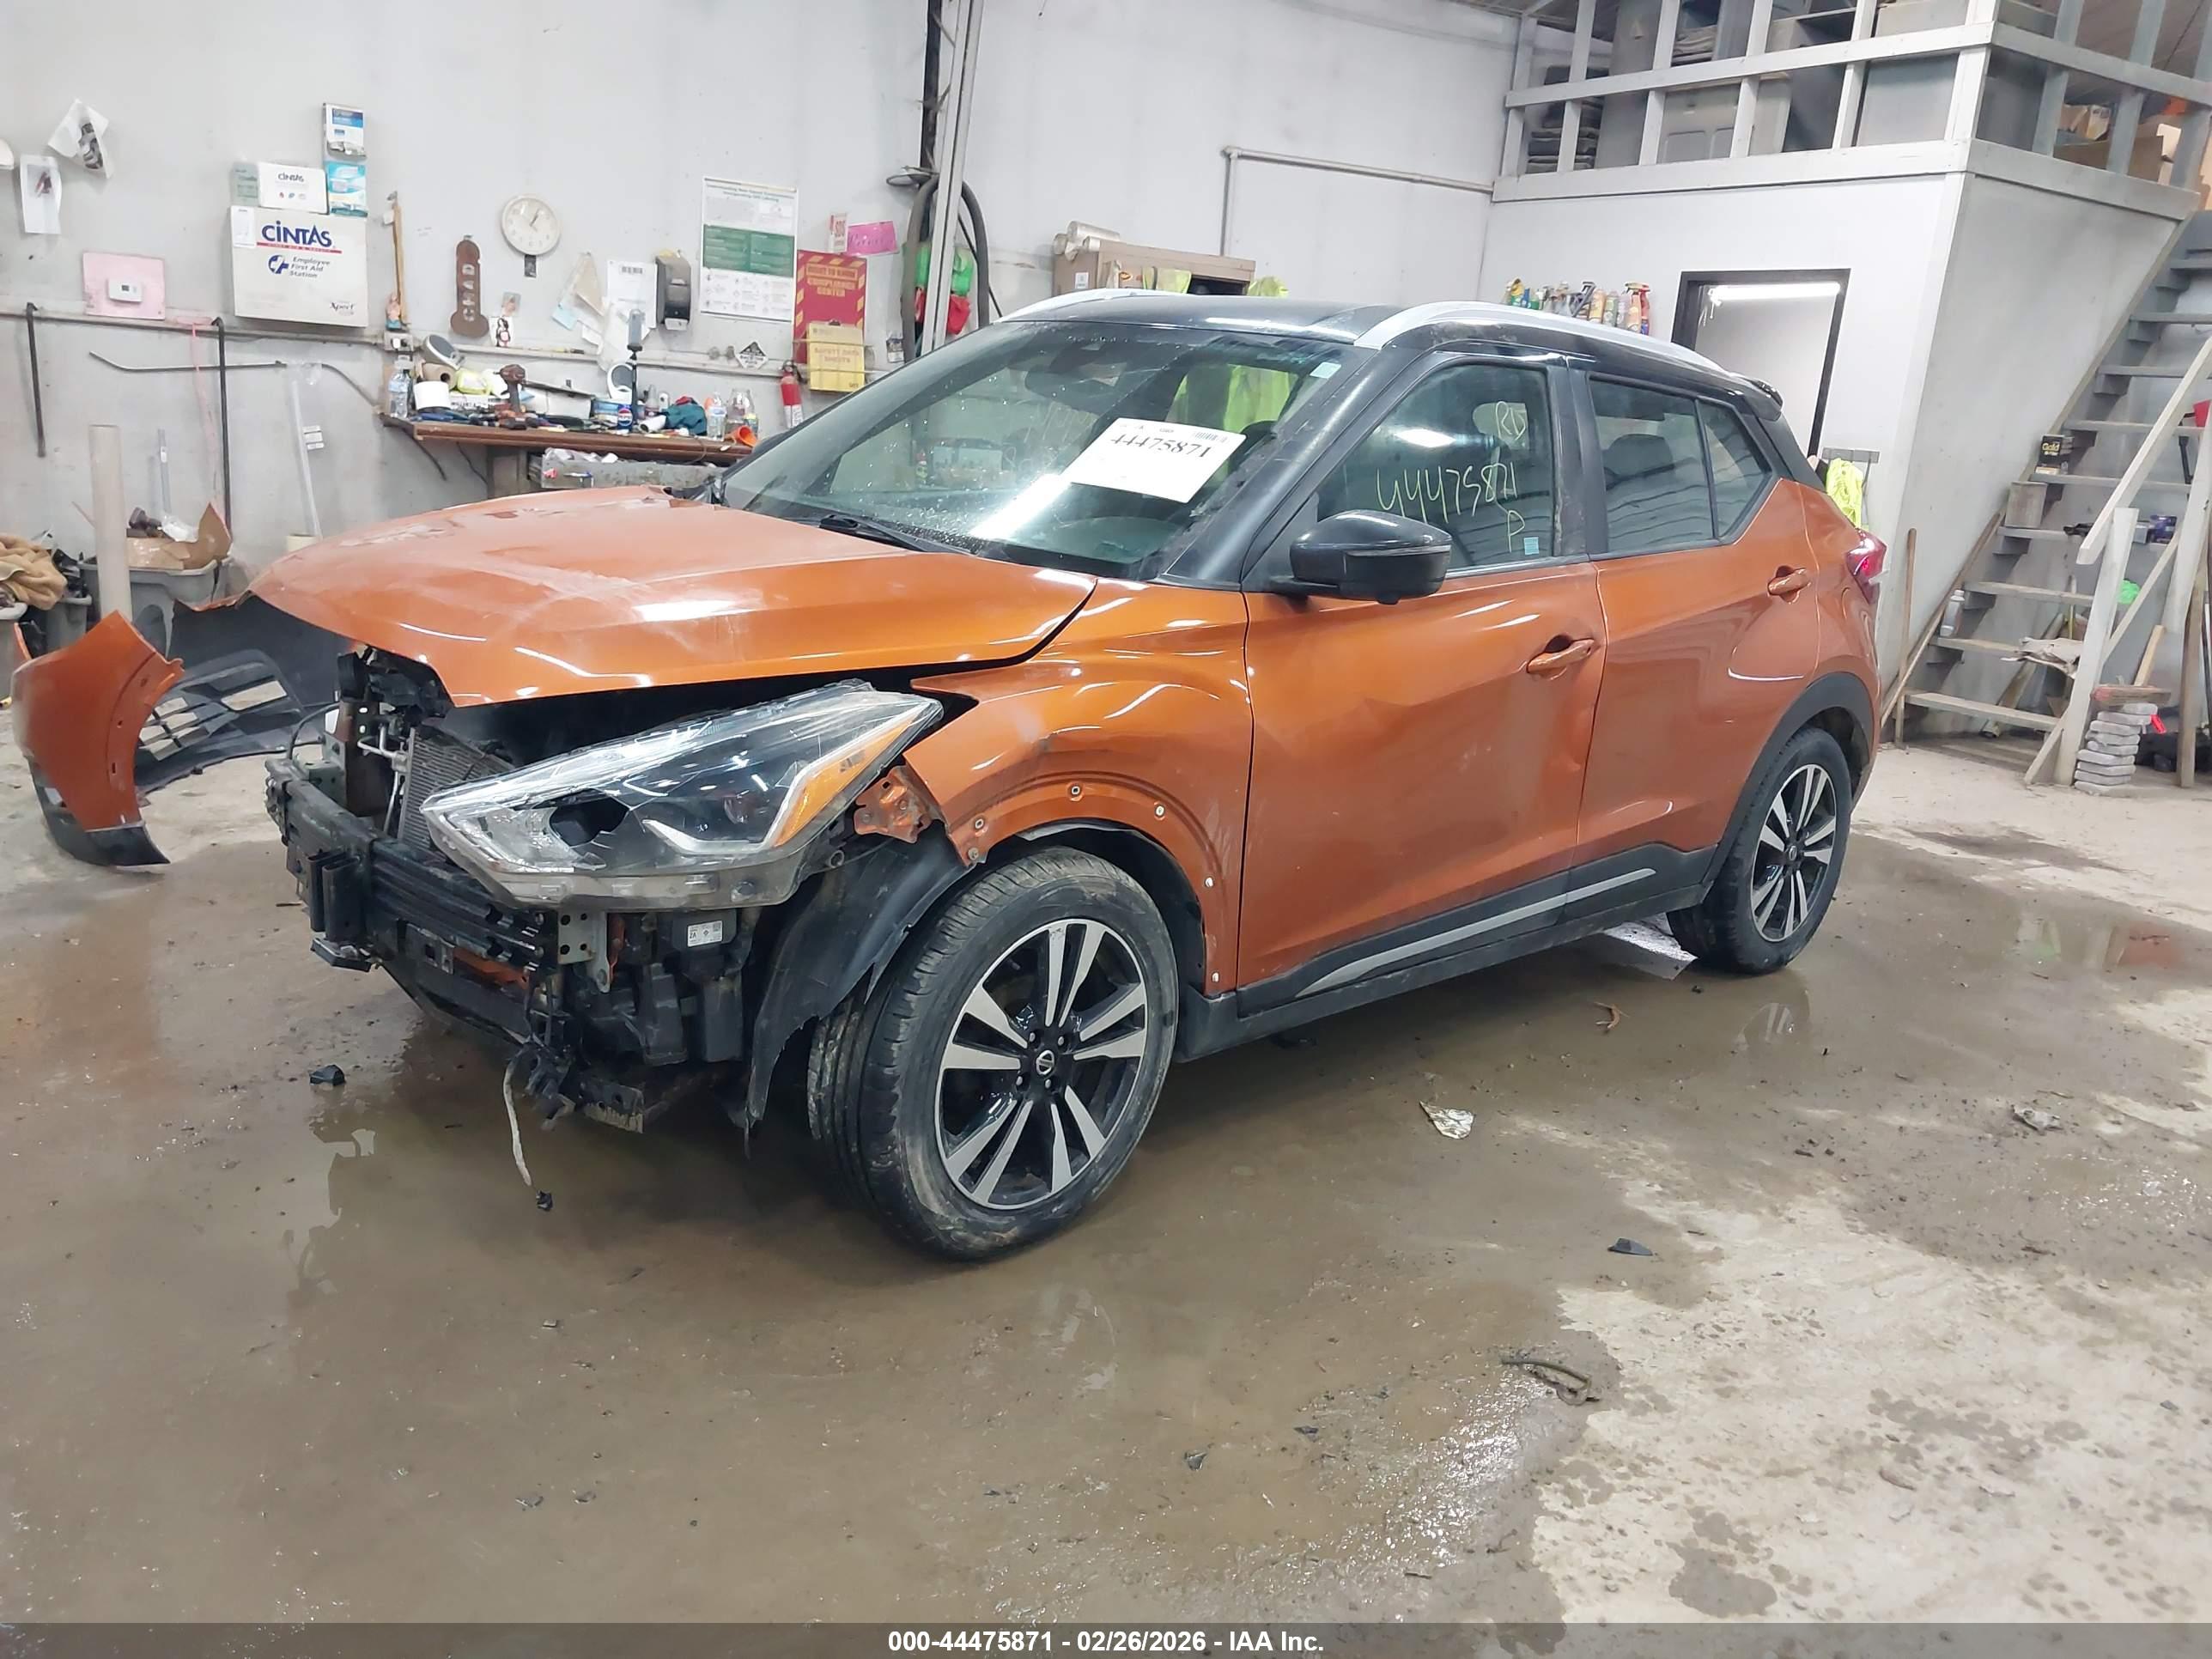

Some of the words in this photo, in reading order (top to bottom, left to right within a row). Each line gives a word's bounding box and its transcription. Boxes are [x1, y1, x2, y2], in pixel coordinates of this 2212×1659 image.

[293, 256, 331, 267] Employee
[289, 270, 319, 279] Station
[1110, 433, 1212, 458] 44475871
[2042, 441, 2061, 452] Gold
[1376, 461, 1518, 524] 44475871
